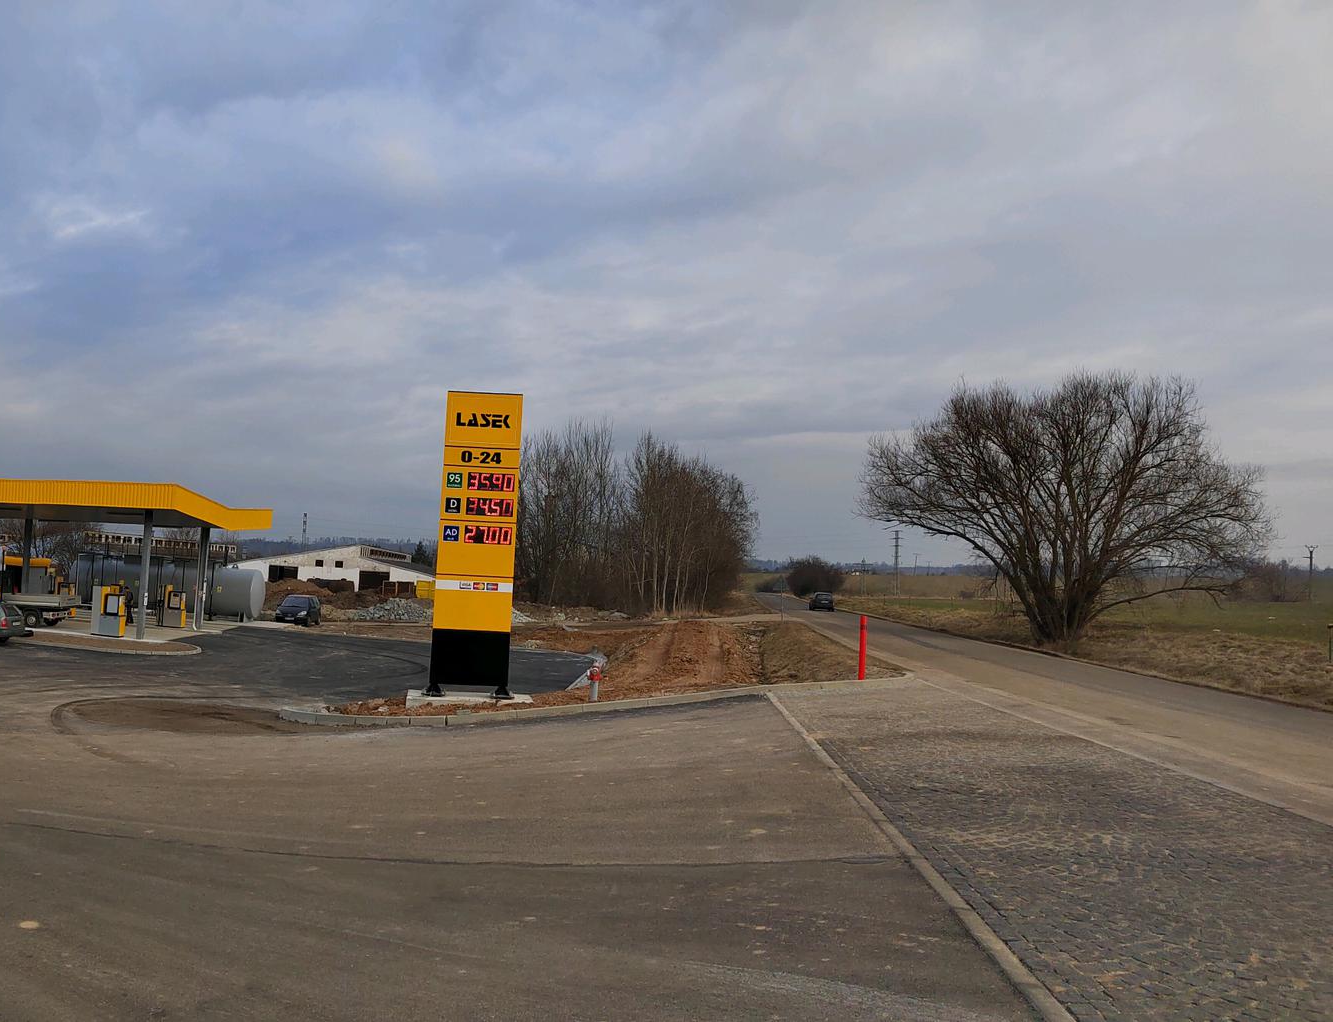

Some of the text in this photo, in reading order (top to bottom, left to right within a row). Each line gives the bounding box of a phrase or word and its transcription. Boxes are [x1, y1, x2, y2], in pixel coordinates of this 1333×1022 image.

[456, 412, 511, 429] LAŠEK
[461, 451, 502, 464] 0-24
[448, 474, 461, 483] 95
[450, 499, 458, 508] D
